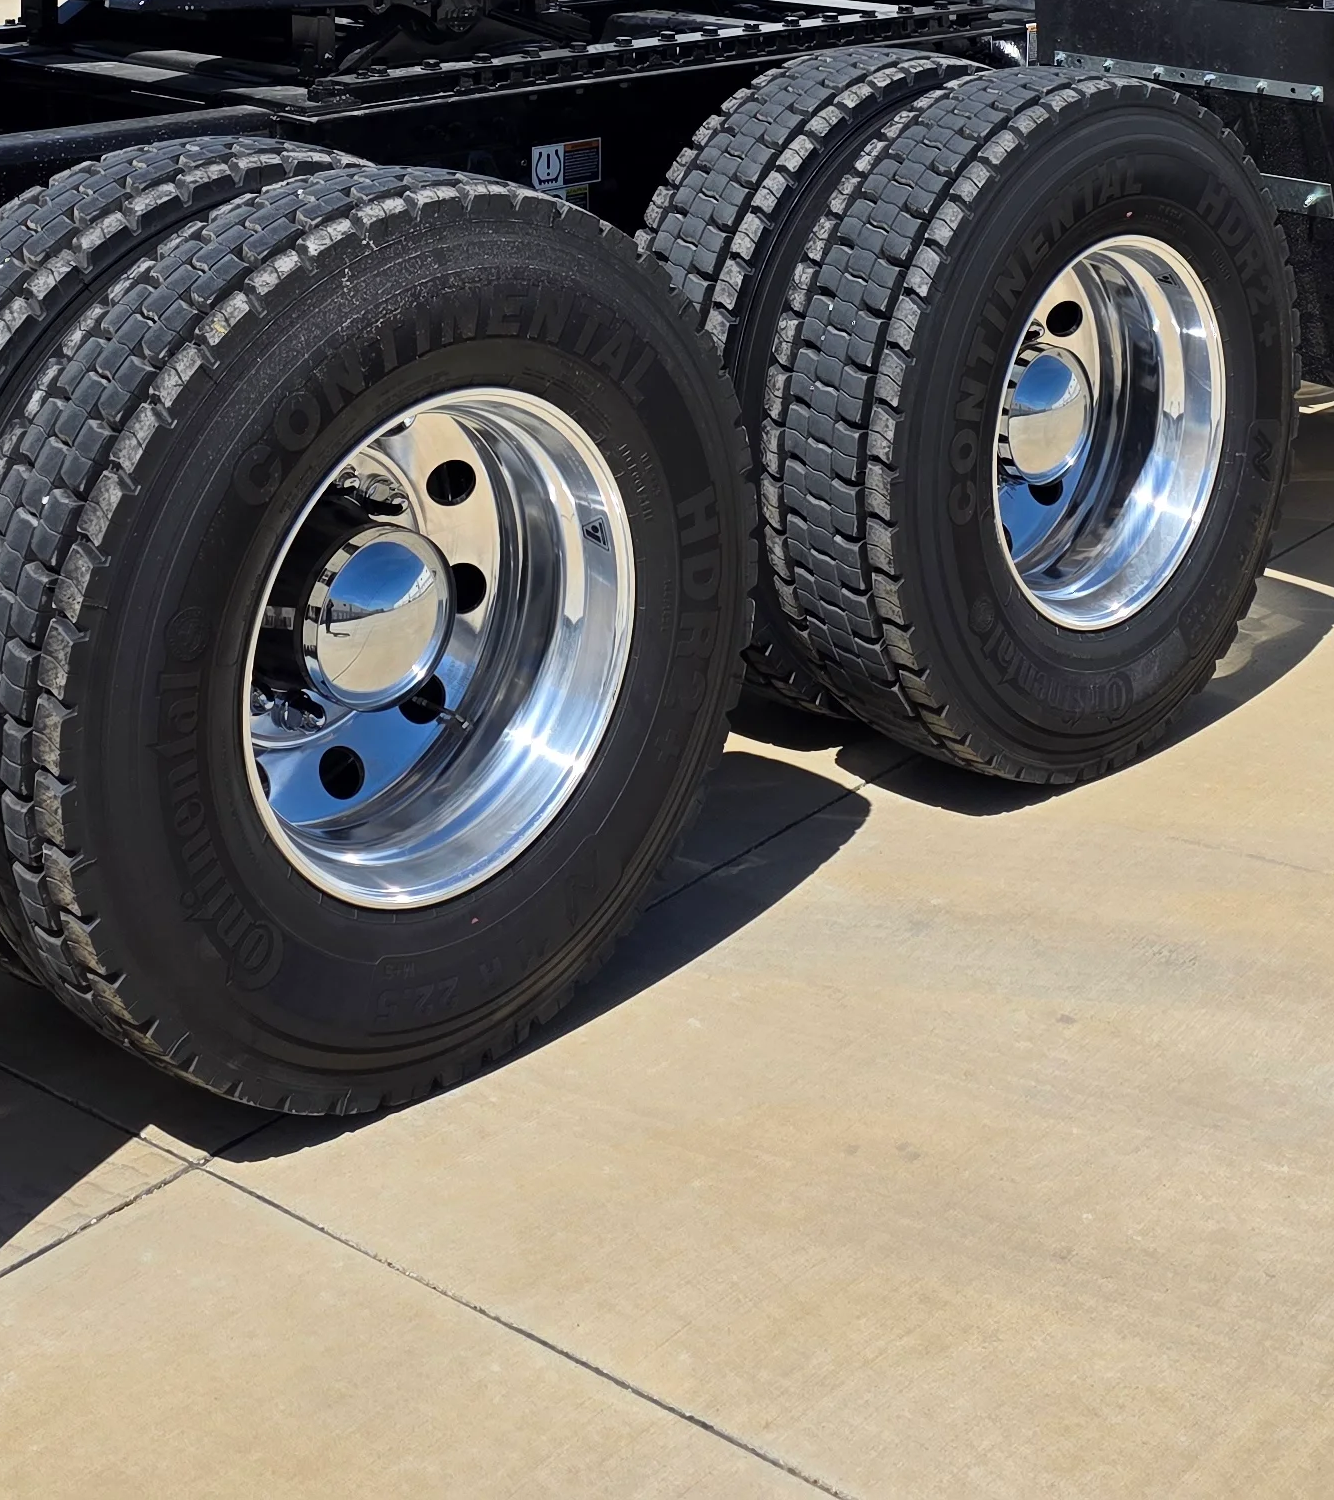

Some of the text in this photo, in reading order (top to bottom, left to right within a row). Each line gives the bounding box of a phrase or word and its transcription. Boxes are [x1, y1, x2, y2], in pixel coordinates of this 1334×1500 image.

[232, 281, 659, 506] CONTINENTAL
[948, 154, 1143, 526] CONTINENTAL
[1196, 174, 1280, 348] HDR2+
[145, 668, 285, 991] Continental
